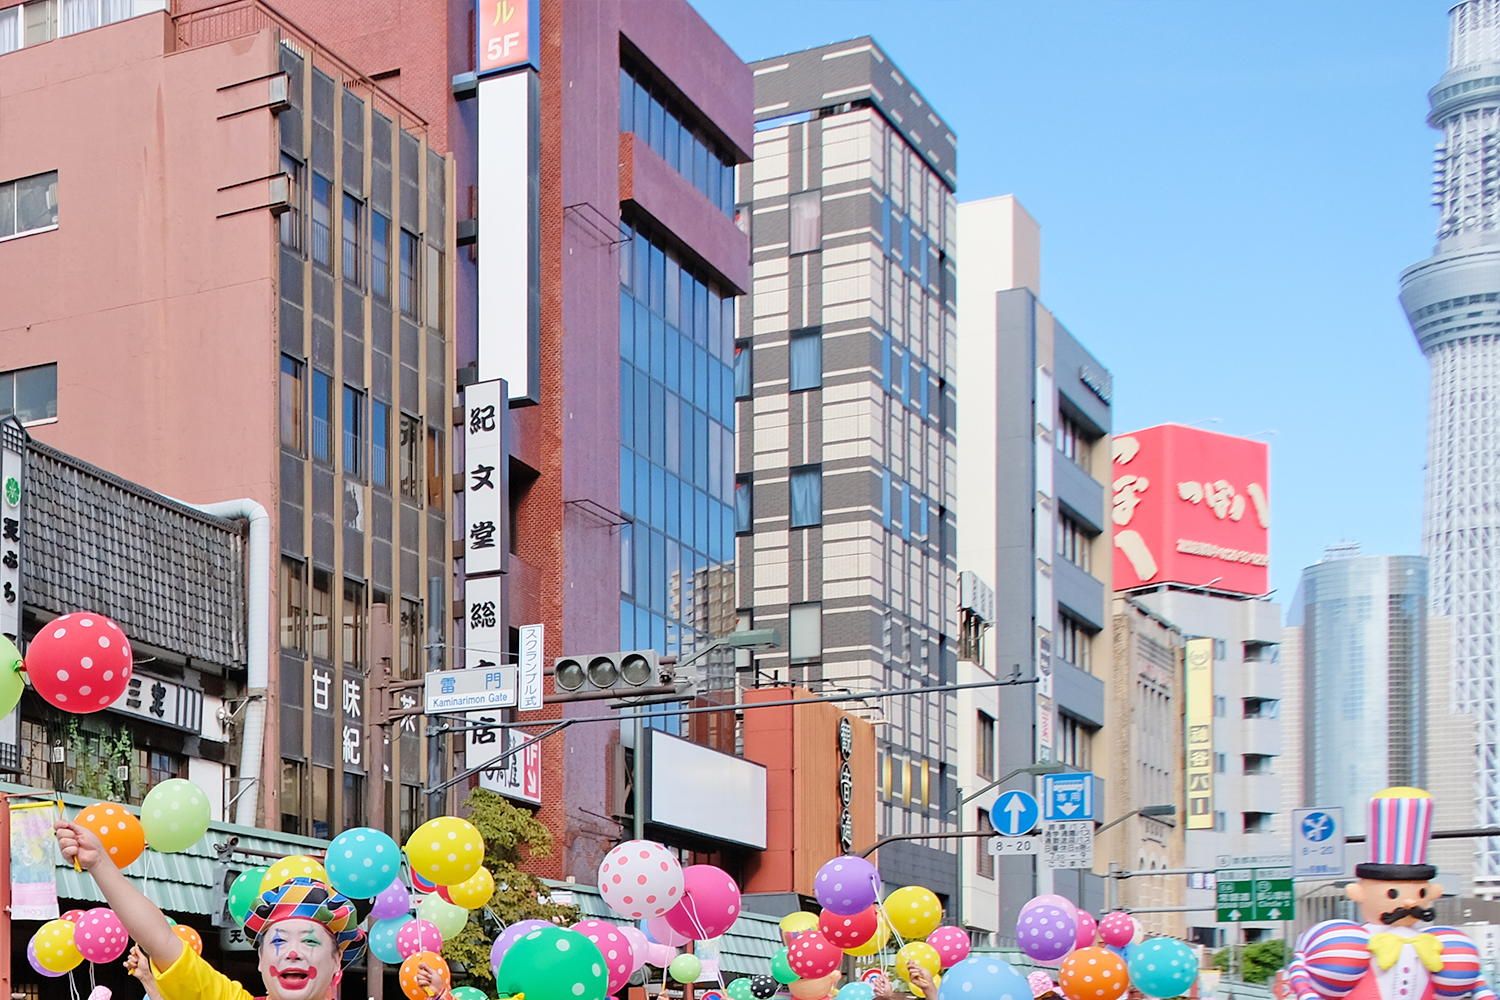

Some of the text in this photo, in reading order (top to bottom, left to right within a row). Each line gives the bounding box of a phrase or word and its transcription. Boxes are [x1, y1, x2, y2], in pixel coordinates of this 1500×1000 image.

[487, 31, 520, 60] 5F
[2, 517, 21, 604] 天ぷら
[469, 406, 497, 745] 紀文堂総店
[432, 692, 508, 708] Kaminarimon Gate
[440, 672, 502, 694] 雷門
[524, 629, 540, 707] スクランブル式
[1190, 724, 1211, 816] 神谷バー
